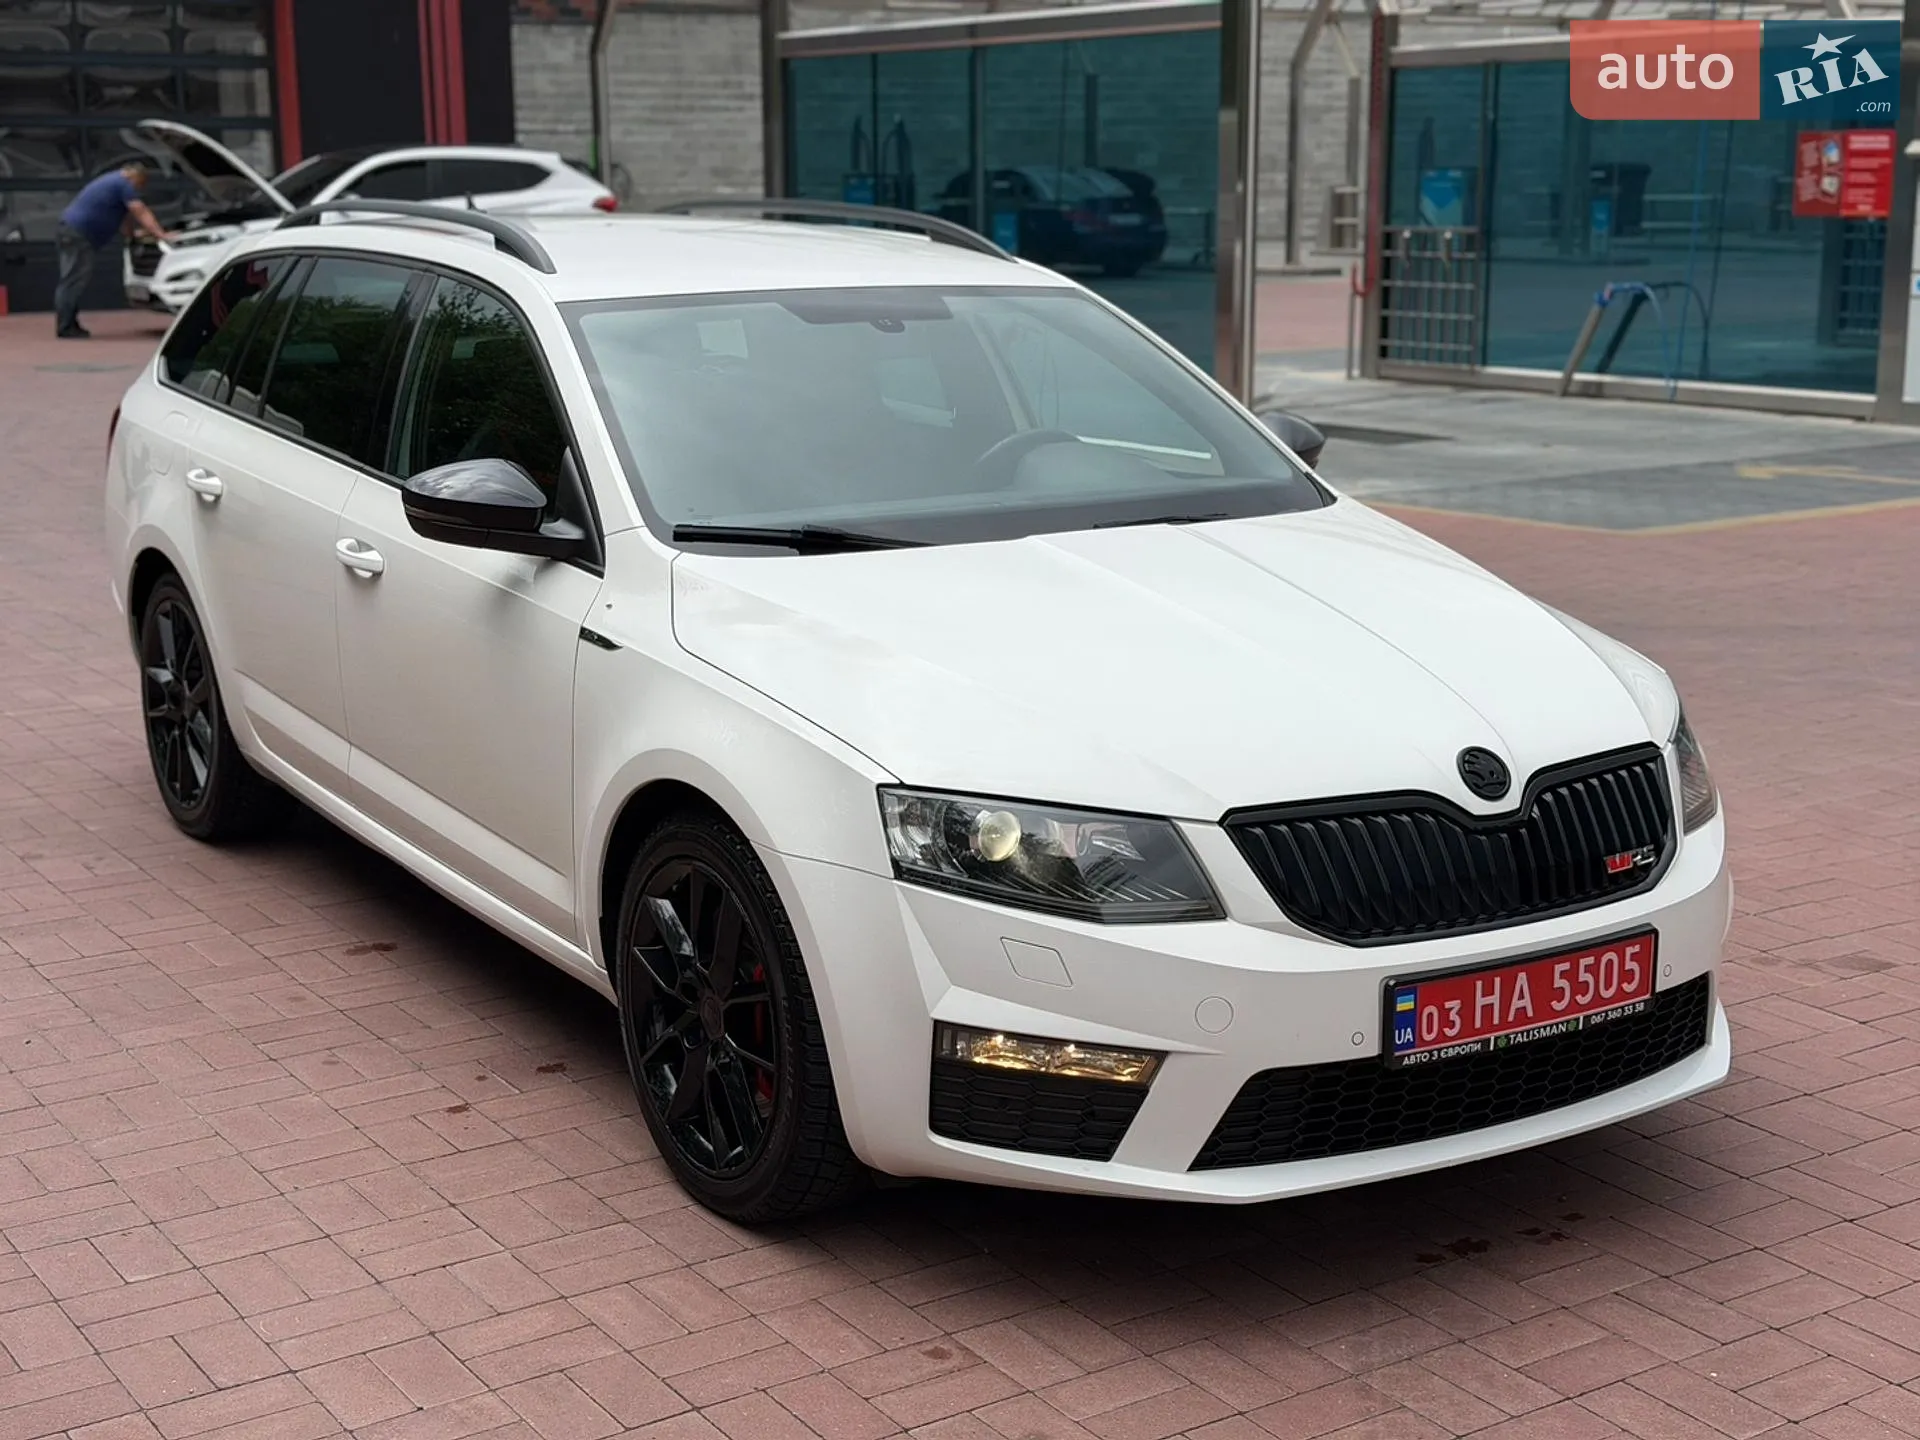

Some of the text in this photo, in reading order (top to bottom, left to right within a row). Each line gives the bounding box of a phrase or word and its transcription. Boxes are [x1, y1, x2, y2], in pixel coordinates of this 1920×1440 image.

[1421, 944, 1641, 1042] 03 HA 5505
[1394, 1027, 1414, 1045] UA
[1509, 1022, 1568, 1046] TALISMAN
